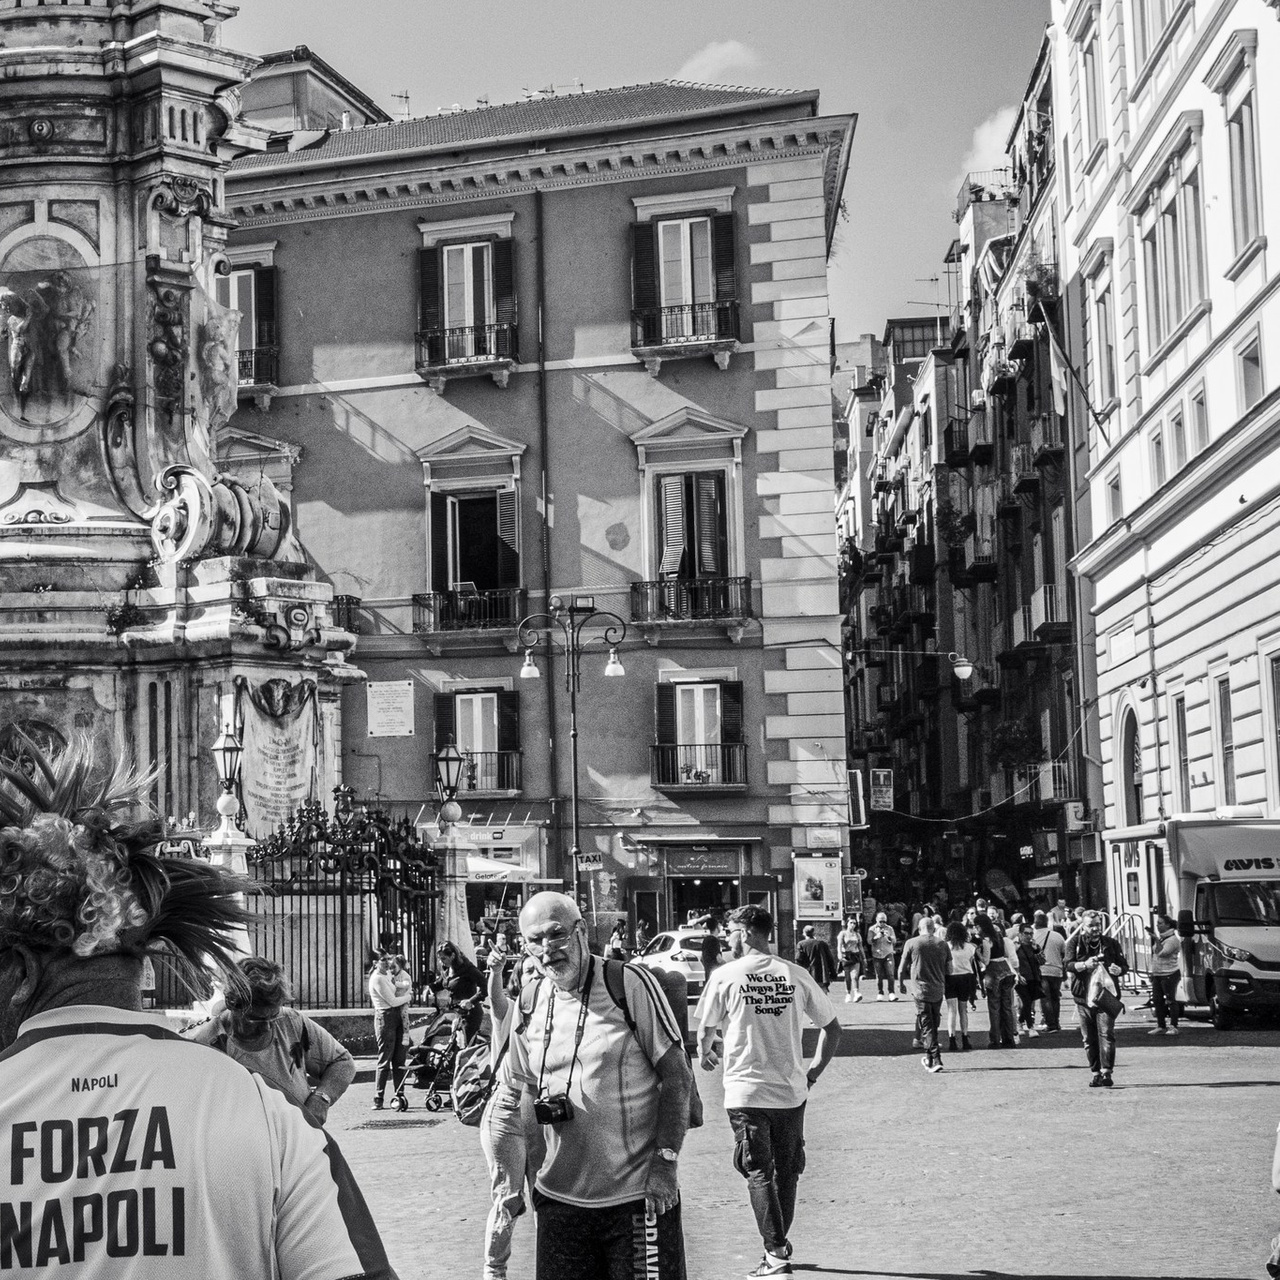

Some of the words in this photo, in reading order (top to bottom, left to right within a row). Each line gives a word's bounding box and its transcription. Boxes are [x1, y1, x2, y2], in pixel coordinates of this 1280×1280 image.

[876, 771, 888, 784] T
[578, 854, 602, 864] TAXI
[1224, 858, 1275, 871] AVIS
[745, 974, 763, 982] We
[764, 974, 787, 982] Can
[739, 984, 774, 996] Always
[774, 982, 796, 996] Play
[742, 995, 764, 1005] The
[764, 994, 794, 1004] Piano
[71, 1073, 118, 1092] NAPOLI
[10, 1105, 176, 1186] FORZA
[0, 1186, 186, 1270] NAPOLI
